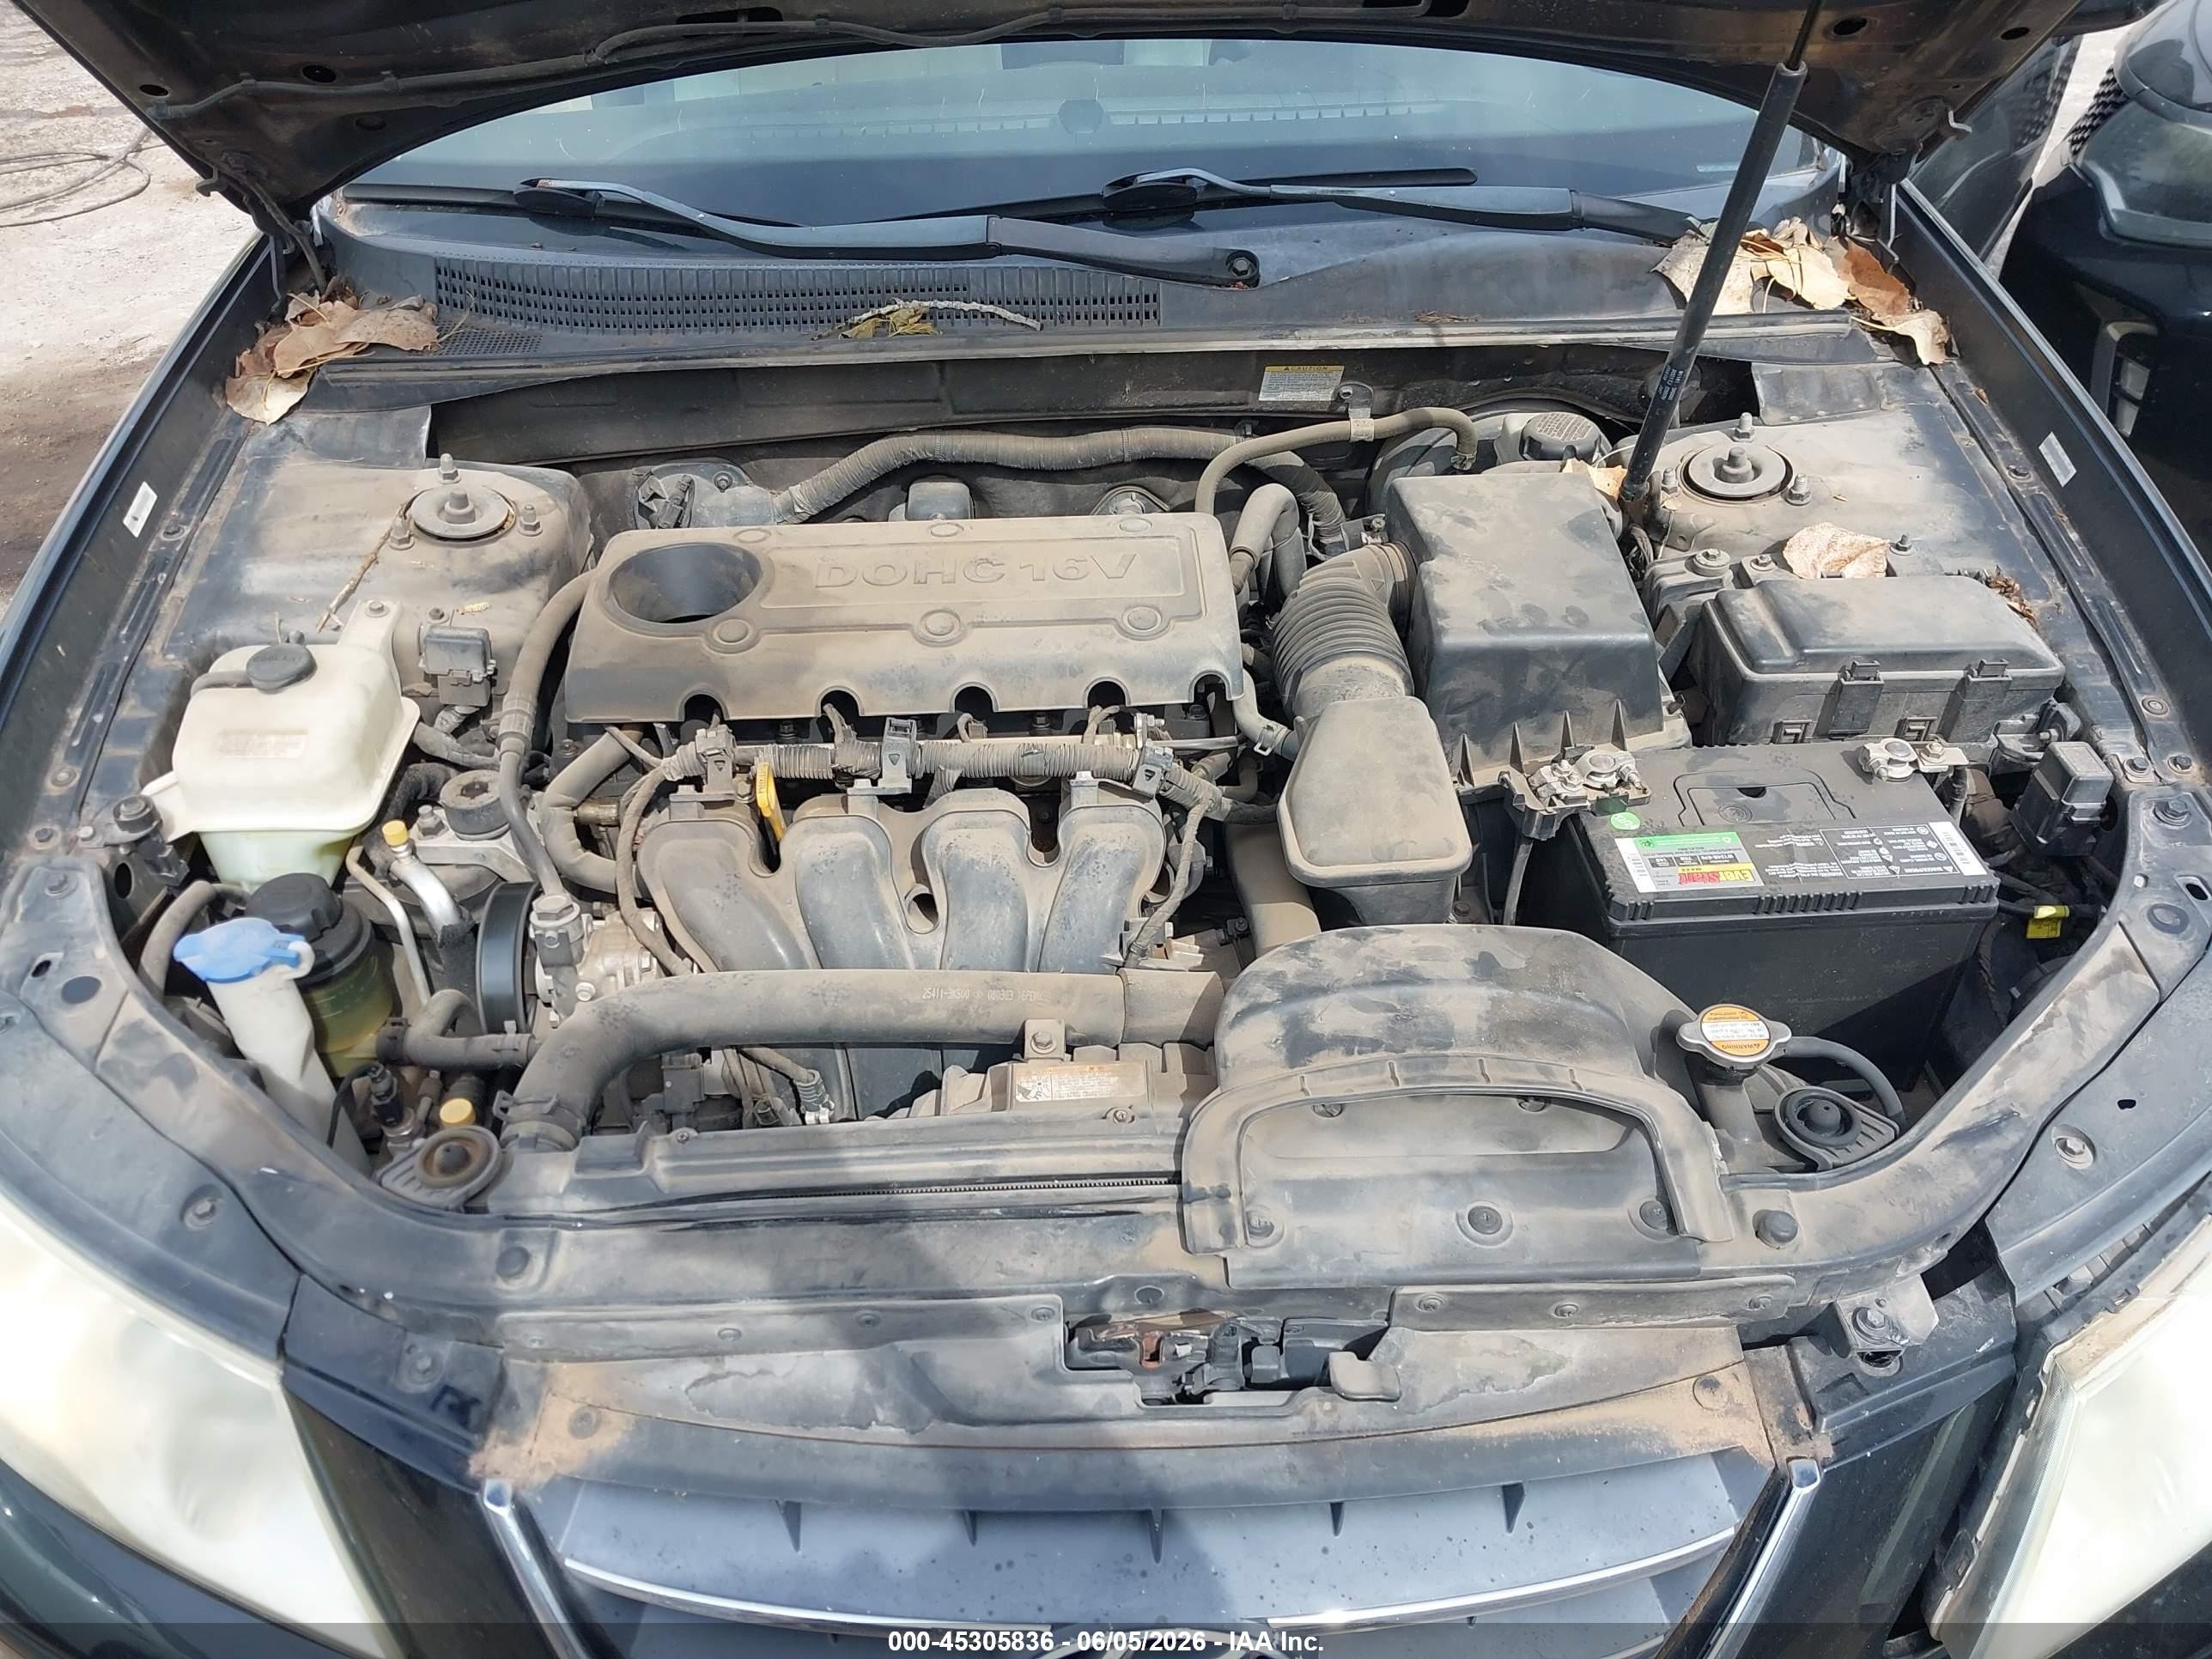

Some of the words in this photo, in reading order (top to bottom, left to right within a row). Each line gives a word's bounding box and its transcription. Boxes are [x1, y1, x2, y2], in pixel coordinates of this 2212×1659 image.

[815, 556, 1006, 588] DOHC
[1018, 553, 1137, 582] 16V
[1678, 868, 1755, 885] EverStart
